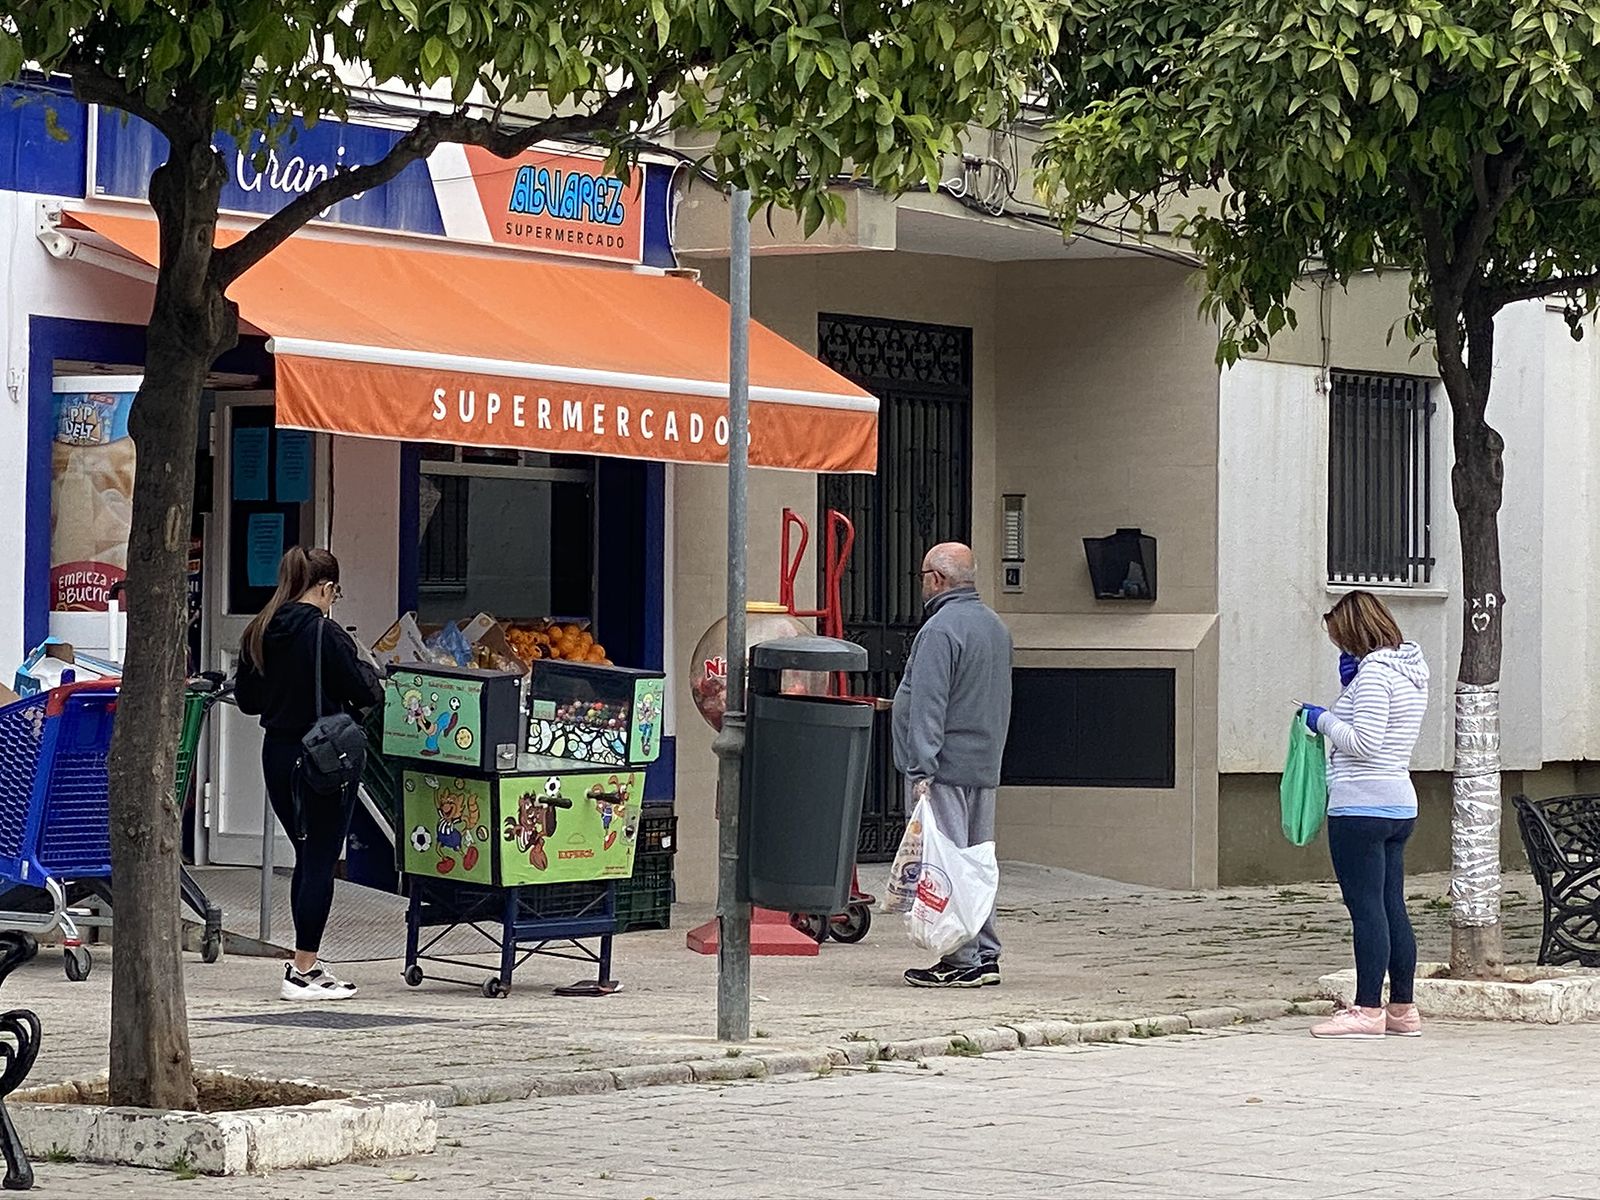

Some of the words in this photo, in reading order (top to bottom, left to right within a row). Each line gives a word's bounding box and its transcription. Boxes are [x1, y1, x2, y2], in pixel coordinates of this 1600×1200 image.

[508, 164, 626, 226] ALVAREZ
[505, 222, 625, 249] SUPERMERCADO
[432, 387, 752, 448] SUPERMERCADO
[1485, 593, 1497, 608] A
